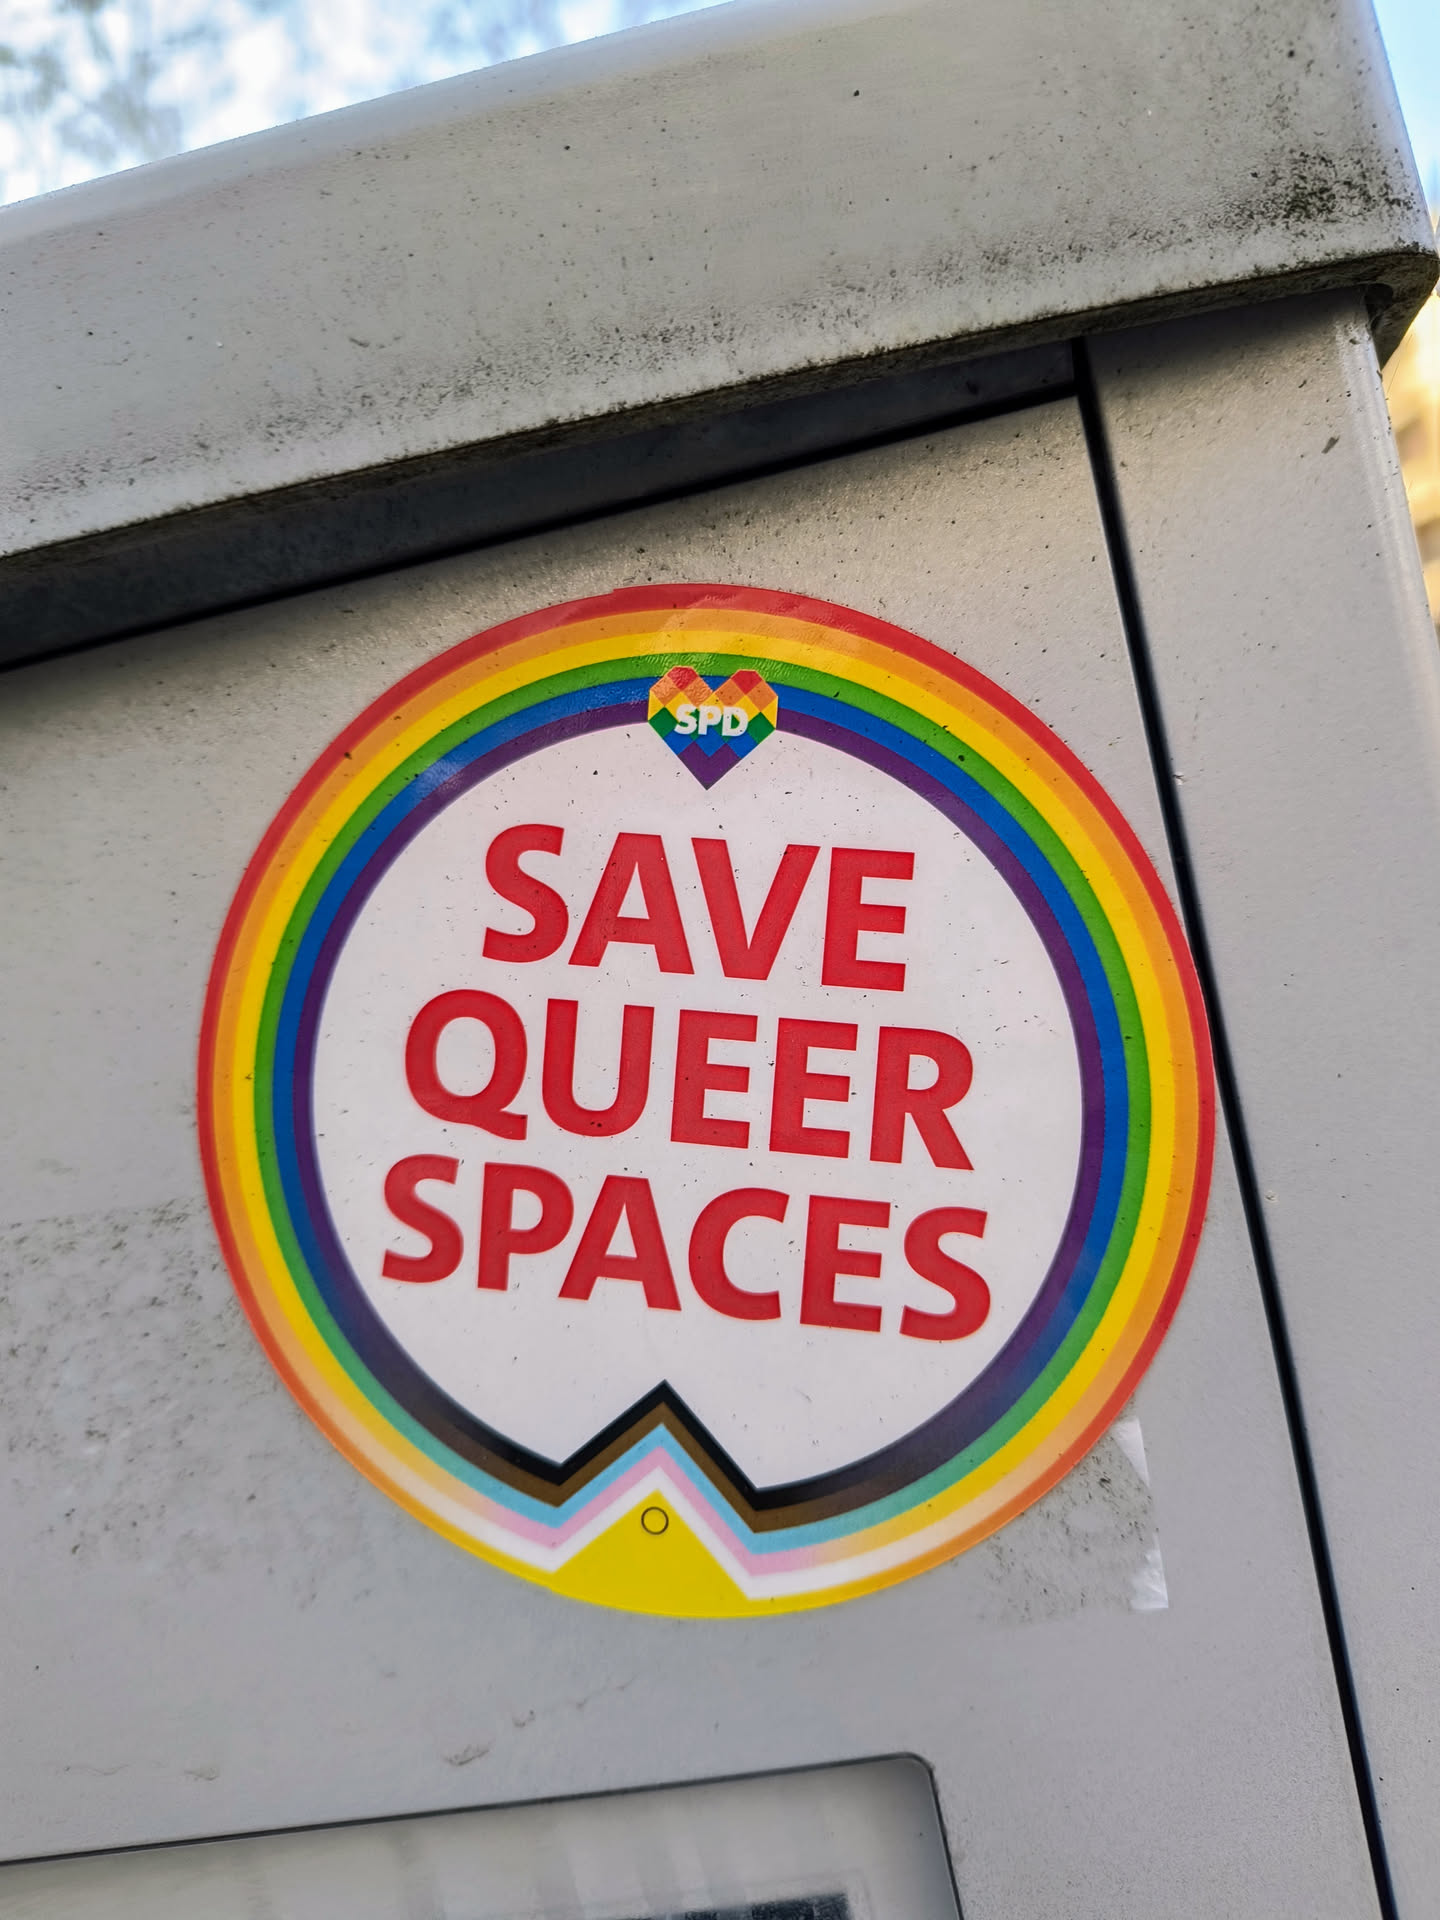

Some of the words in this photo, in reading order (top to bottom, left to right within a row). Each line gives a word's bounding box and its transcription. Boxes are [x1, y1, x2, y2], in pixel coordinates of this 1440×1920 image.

[673, 703, 749, 736] SPD
[482, 824, 915, 993] SAVE
[405, 989, 973, 1170] QUEER
[382, 1154, 990, 1341] SPACES
